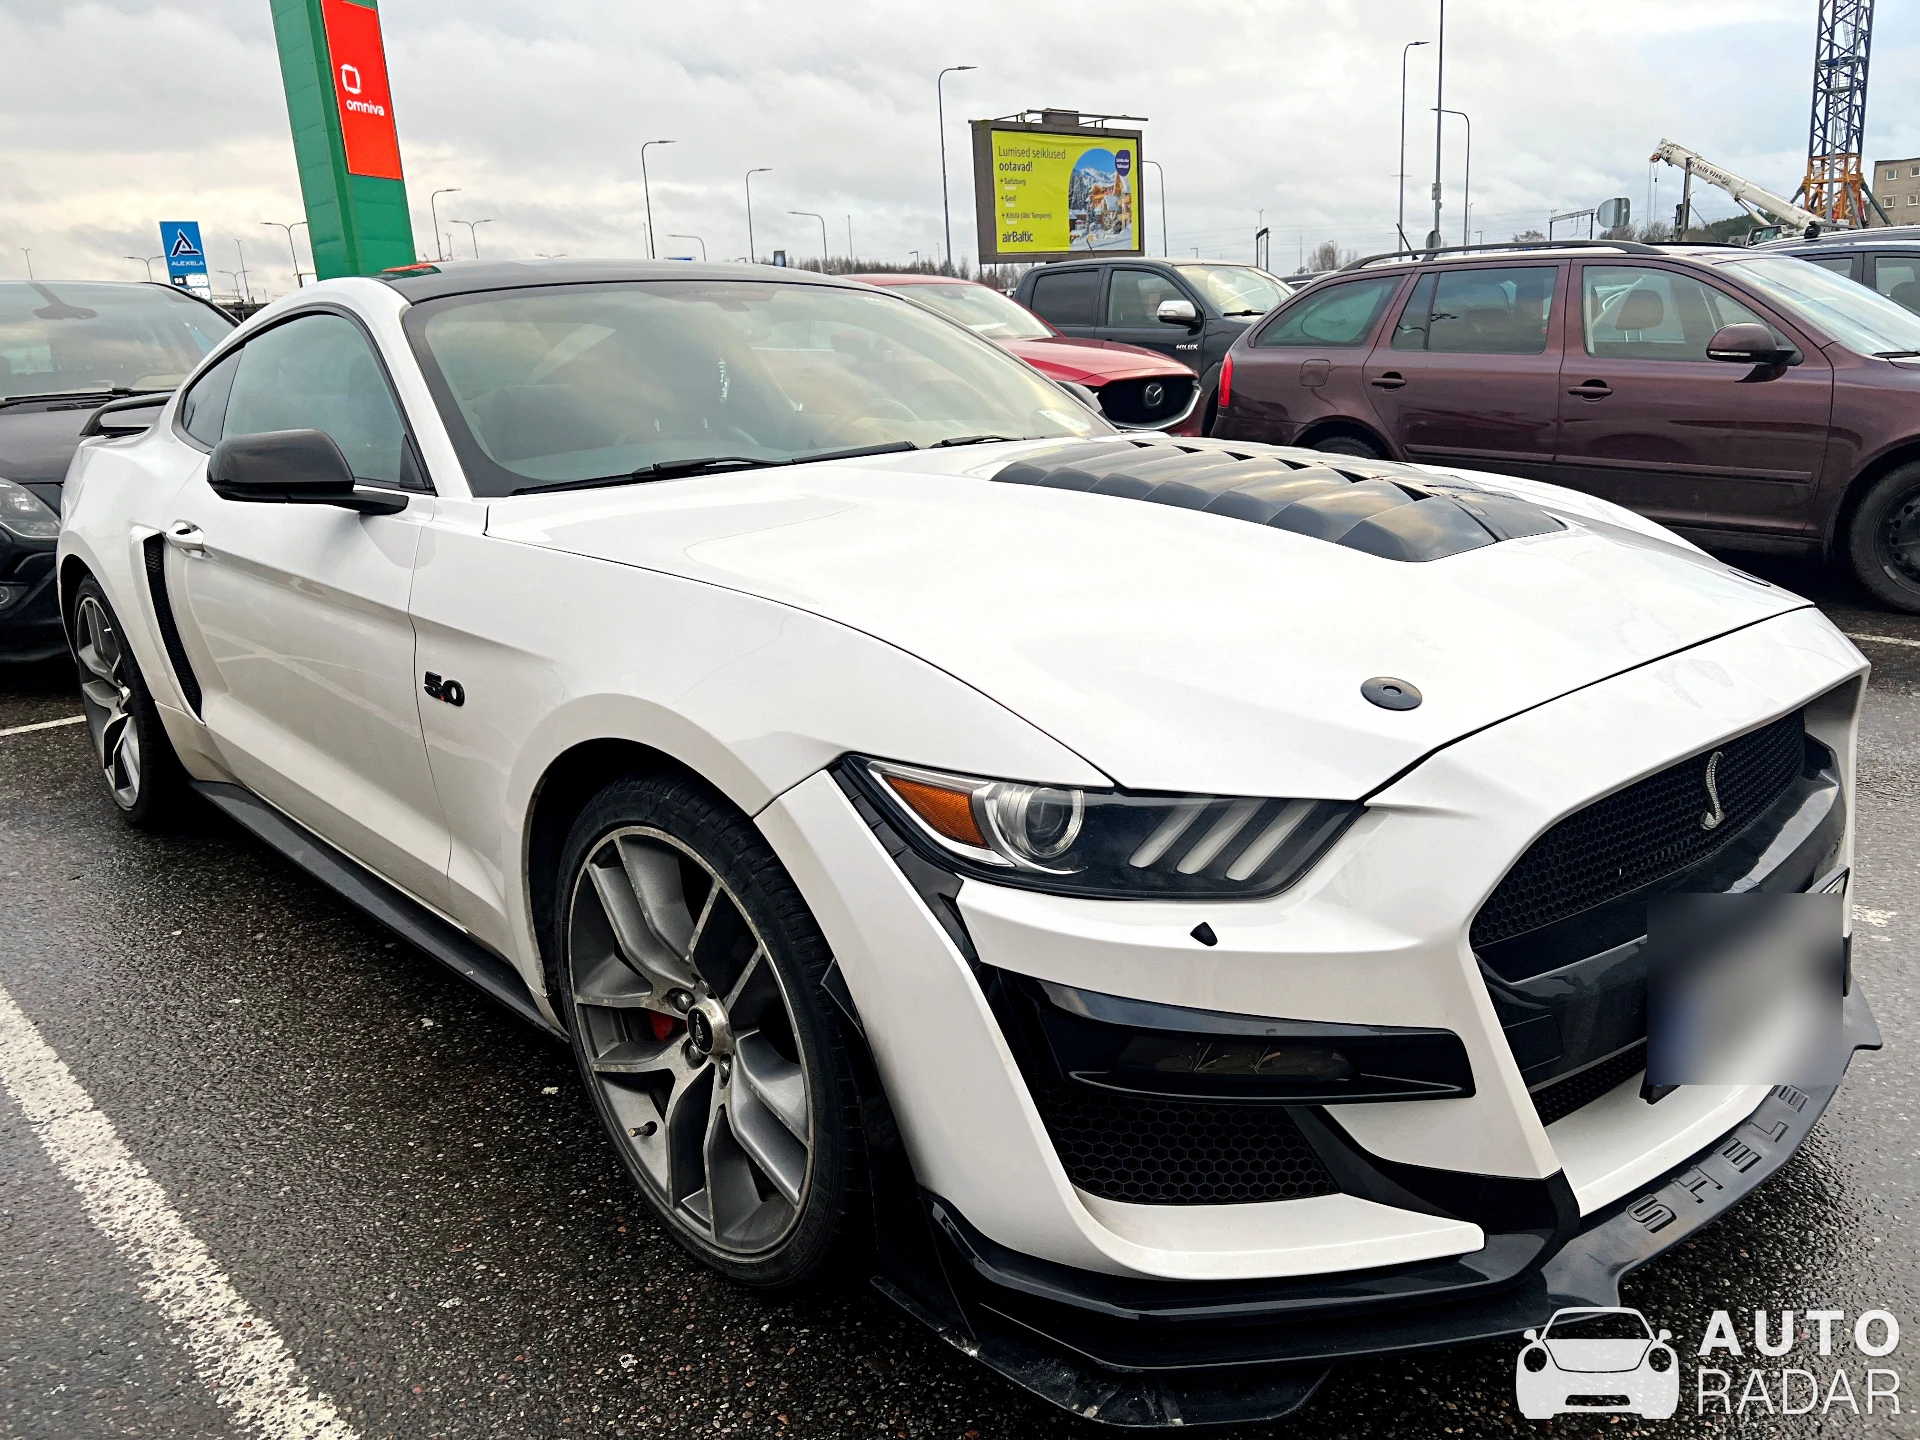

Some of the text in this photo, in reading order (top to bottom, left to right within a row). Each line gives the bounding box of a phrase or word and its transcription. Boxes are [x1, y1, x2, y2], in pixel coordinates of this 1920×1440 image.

[346, 99, 385, 116] omniva
[998, 145, 1066, 160] Lumised seiklused
[999, 161, 1033, 171] ootavad!
[1002, 231, 1033, 242] airBaltic
[424, 670, 465, 708] 5.0
[1625, 1085, 1810, 1234] SHELB
